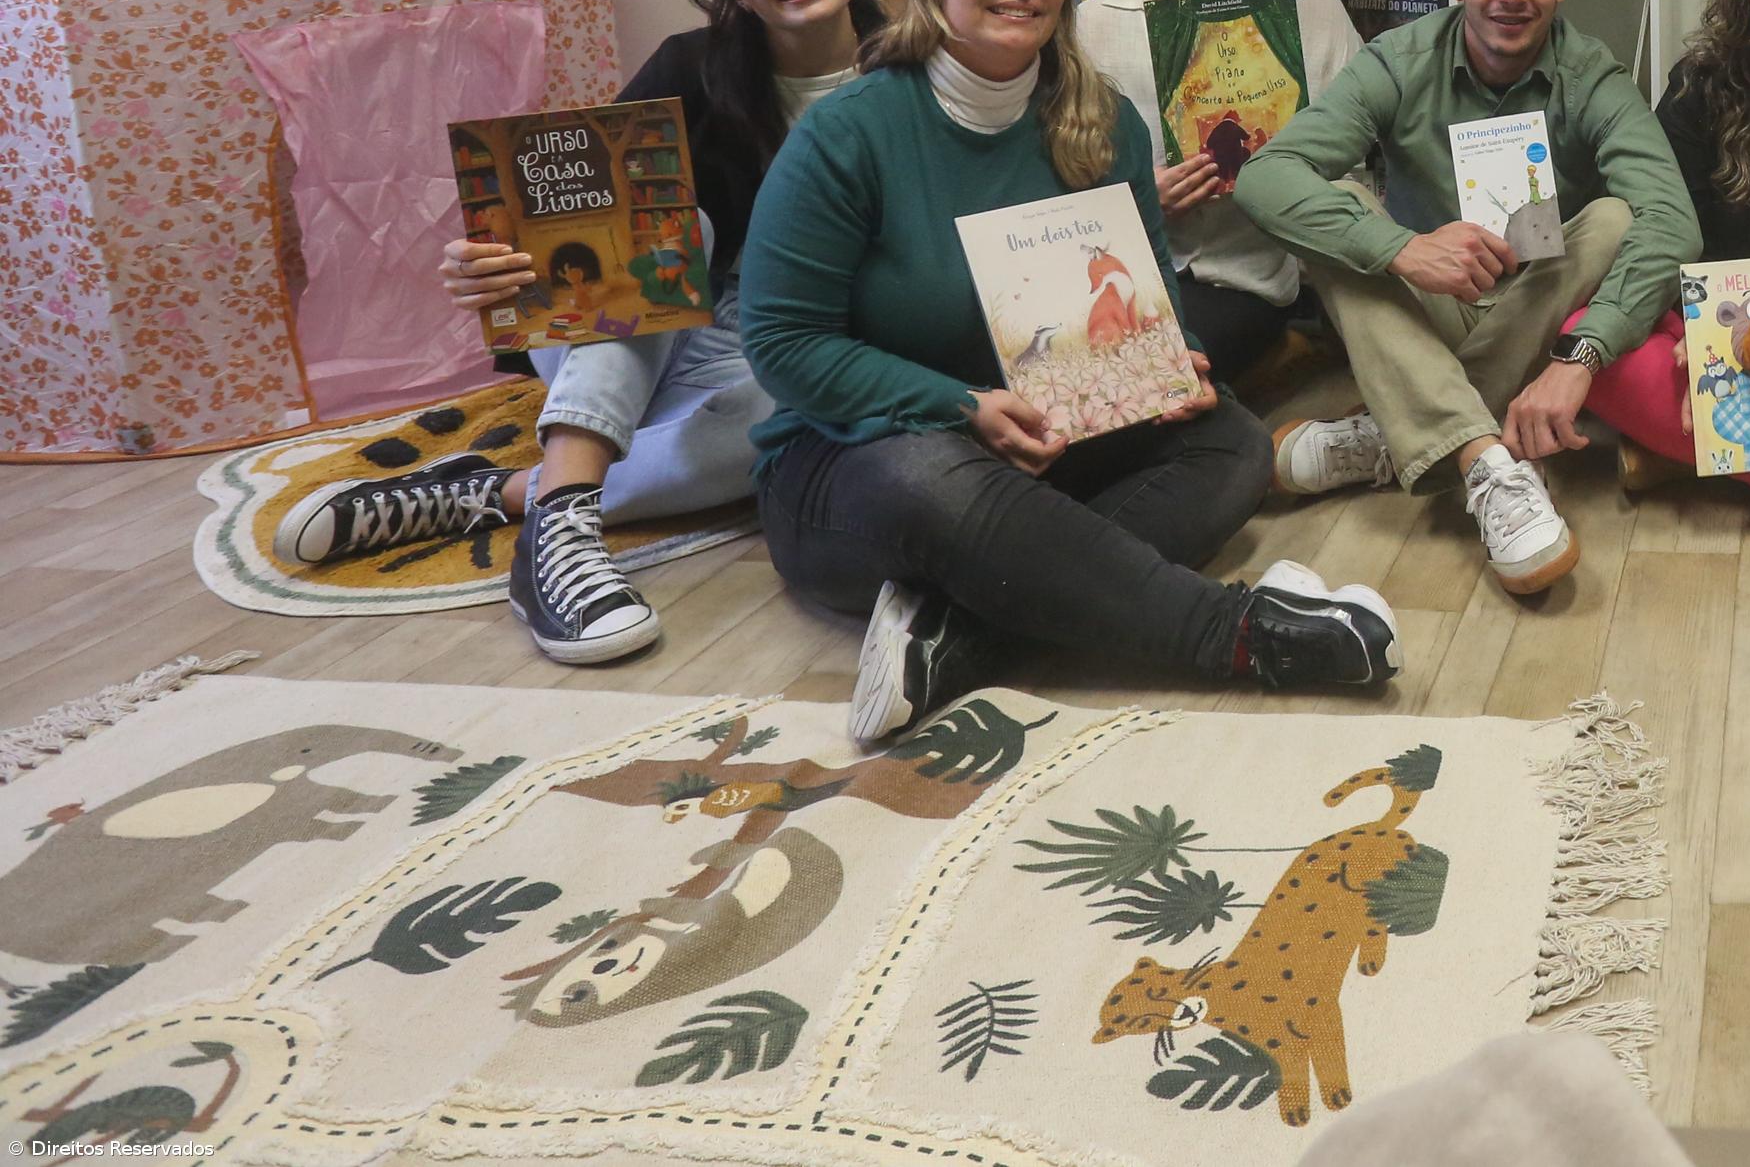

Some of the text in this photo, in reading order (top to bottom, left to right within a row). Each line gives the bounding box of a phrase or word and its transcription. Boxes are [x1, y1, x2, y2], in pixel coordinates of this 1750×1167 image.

[1388, 0, 1400, 10] DO
[1221, 32, 1228, 41] O
[1217, 44, 1236, 59] Urso
[1214, 68, 1245, 82] Piano
[1183, 86, 1222, 104] Concerto
[1236, 90, 1267, 104] Pequena
[1267, 78, 1287, 93] Ursa
[1457, 123, 1532, 141] O Principezinho
[536, 128, 589, 154] URSO
[517, 151, 595, 183] Casa
[556, 182, 583, 191] dos
[527, 182, 613, 214] Livros
[1006, 220, 1103, 252] Um dois três
[1724, 274, 1750, 291] MEL
